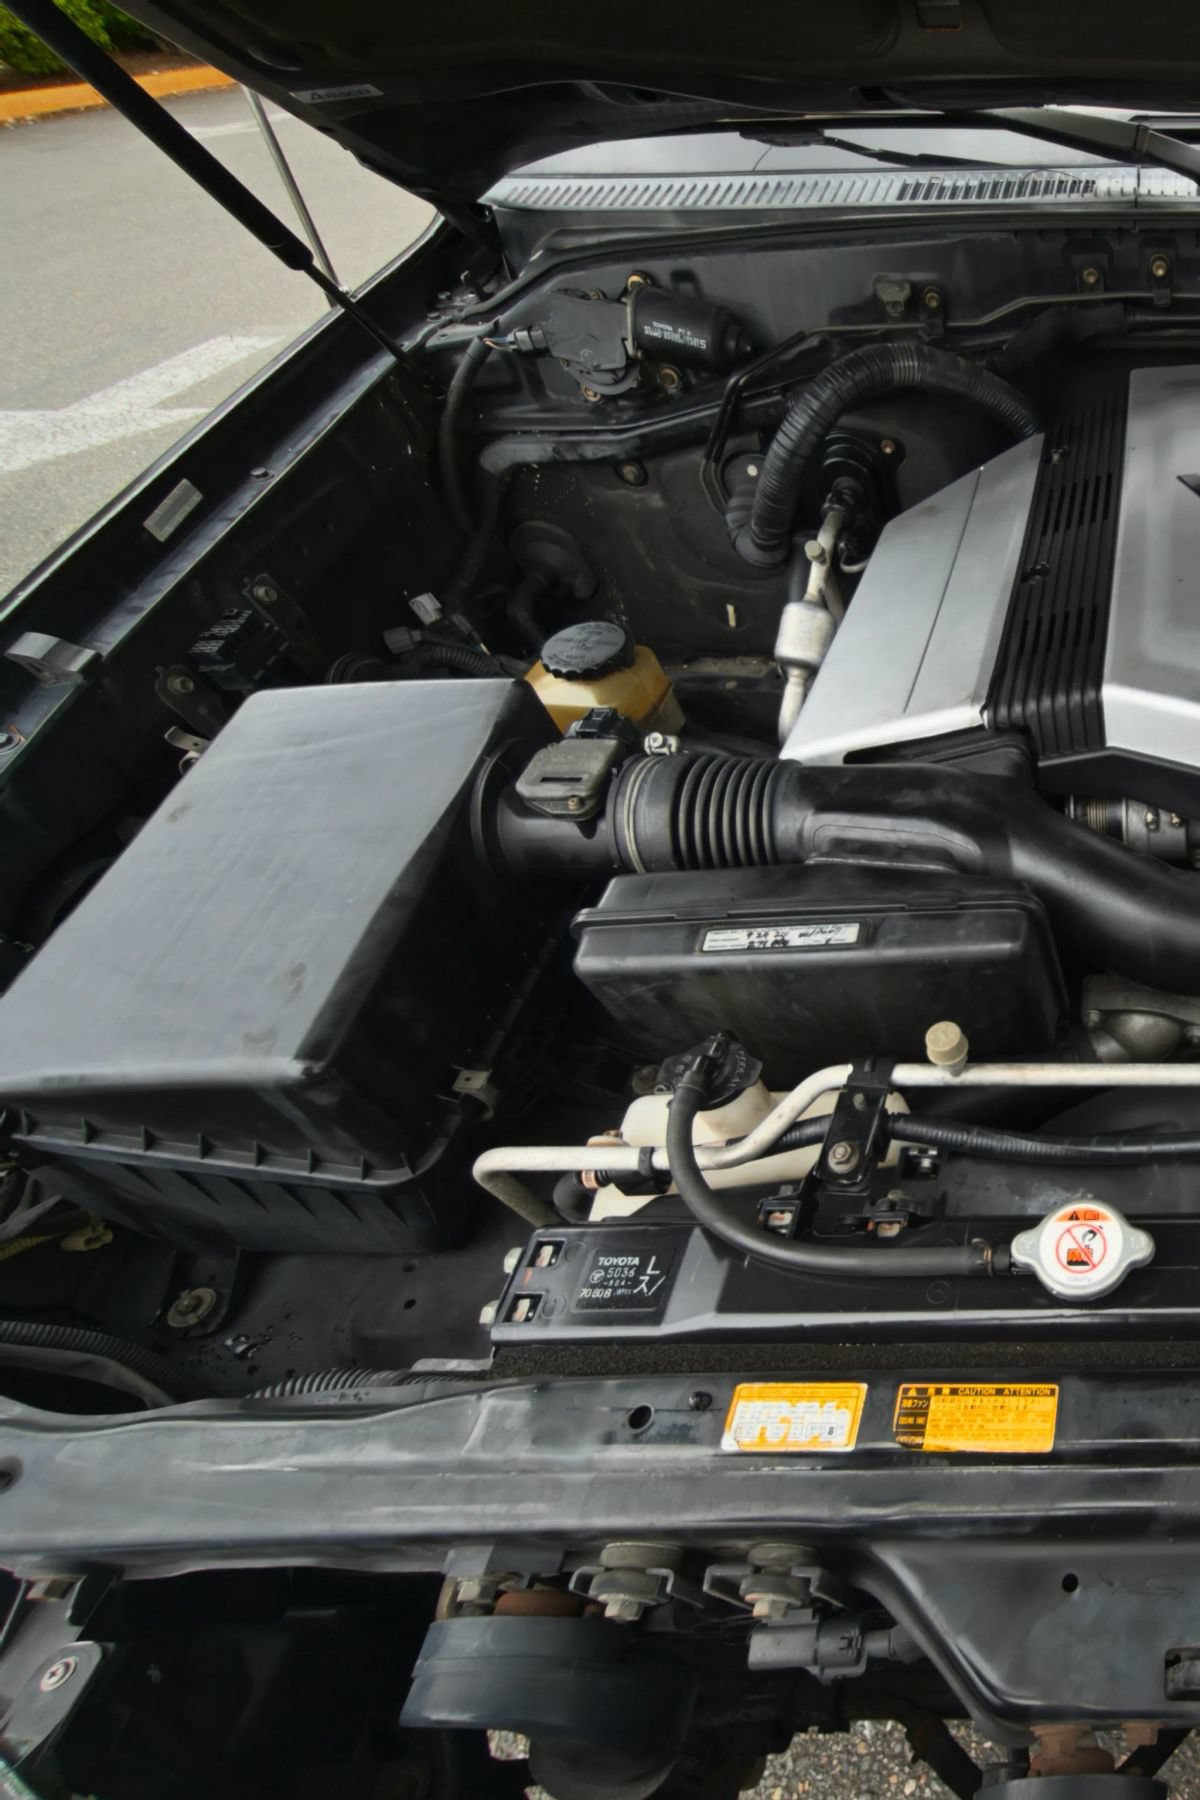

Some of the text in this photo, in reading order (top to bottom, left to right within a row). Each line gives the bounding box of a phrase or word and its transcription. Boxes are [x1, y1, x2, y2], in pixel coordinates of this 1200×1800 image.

[598, 1256, 640, 1267] TOYOTA
[606, 1266, 636, 1279] 5036
[958, 1388, 996, 1397] CAUTION
[1003, 1387, 1051, 1397] ATTENTION
